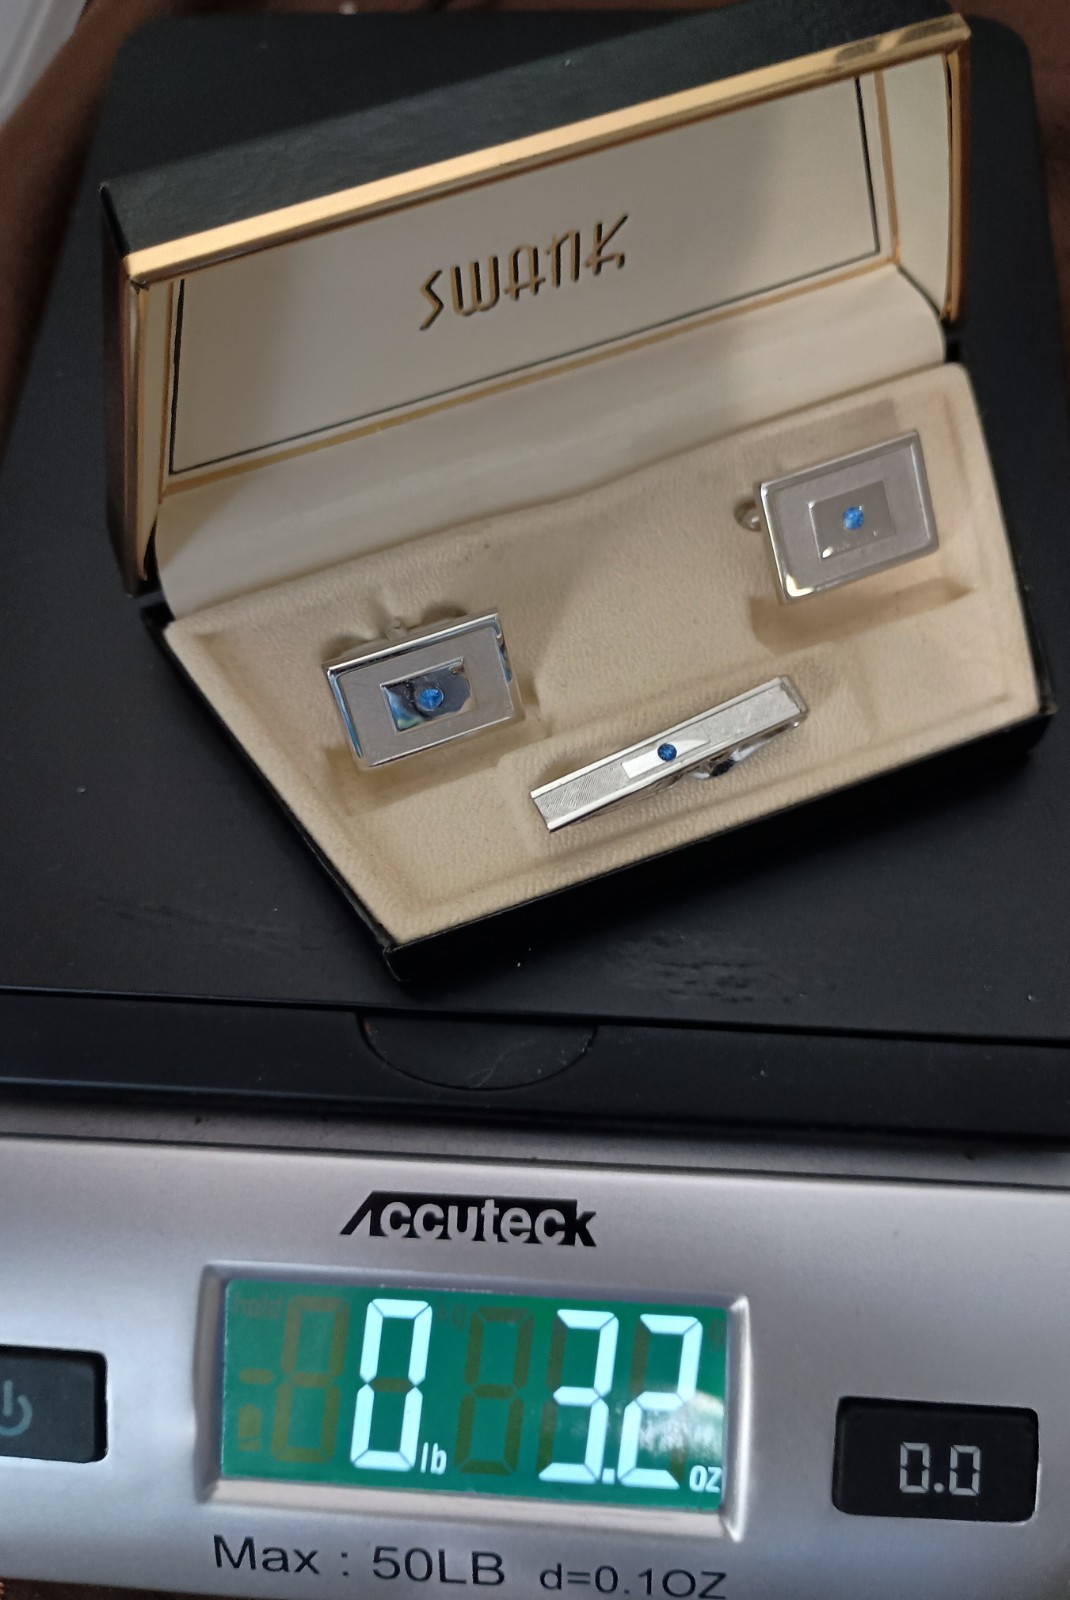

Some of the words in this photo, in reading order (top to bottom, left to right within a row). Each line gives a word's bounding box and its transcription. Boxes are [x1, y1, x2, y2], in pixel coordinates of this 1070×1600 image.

[419, 212, 628, 331] SWANK
[339, 1190, 597, 1247] Accuteck
[350, 1298, 433, 1472] 0
[420, 1442, 447, 1475] lb
[538, 1309, 703, 1491] 3.2
[900, 1441, 981, 1496] 0.0
[213, 1534, 320, 1575] Max
[372, 1545, 505, 1586] 50LB
